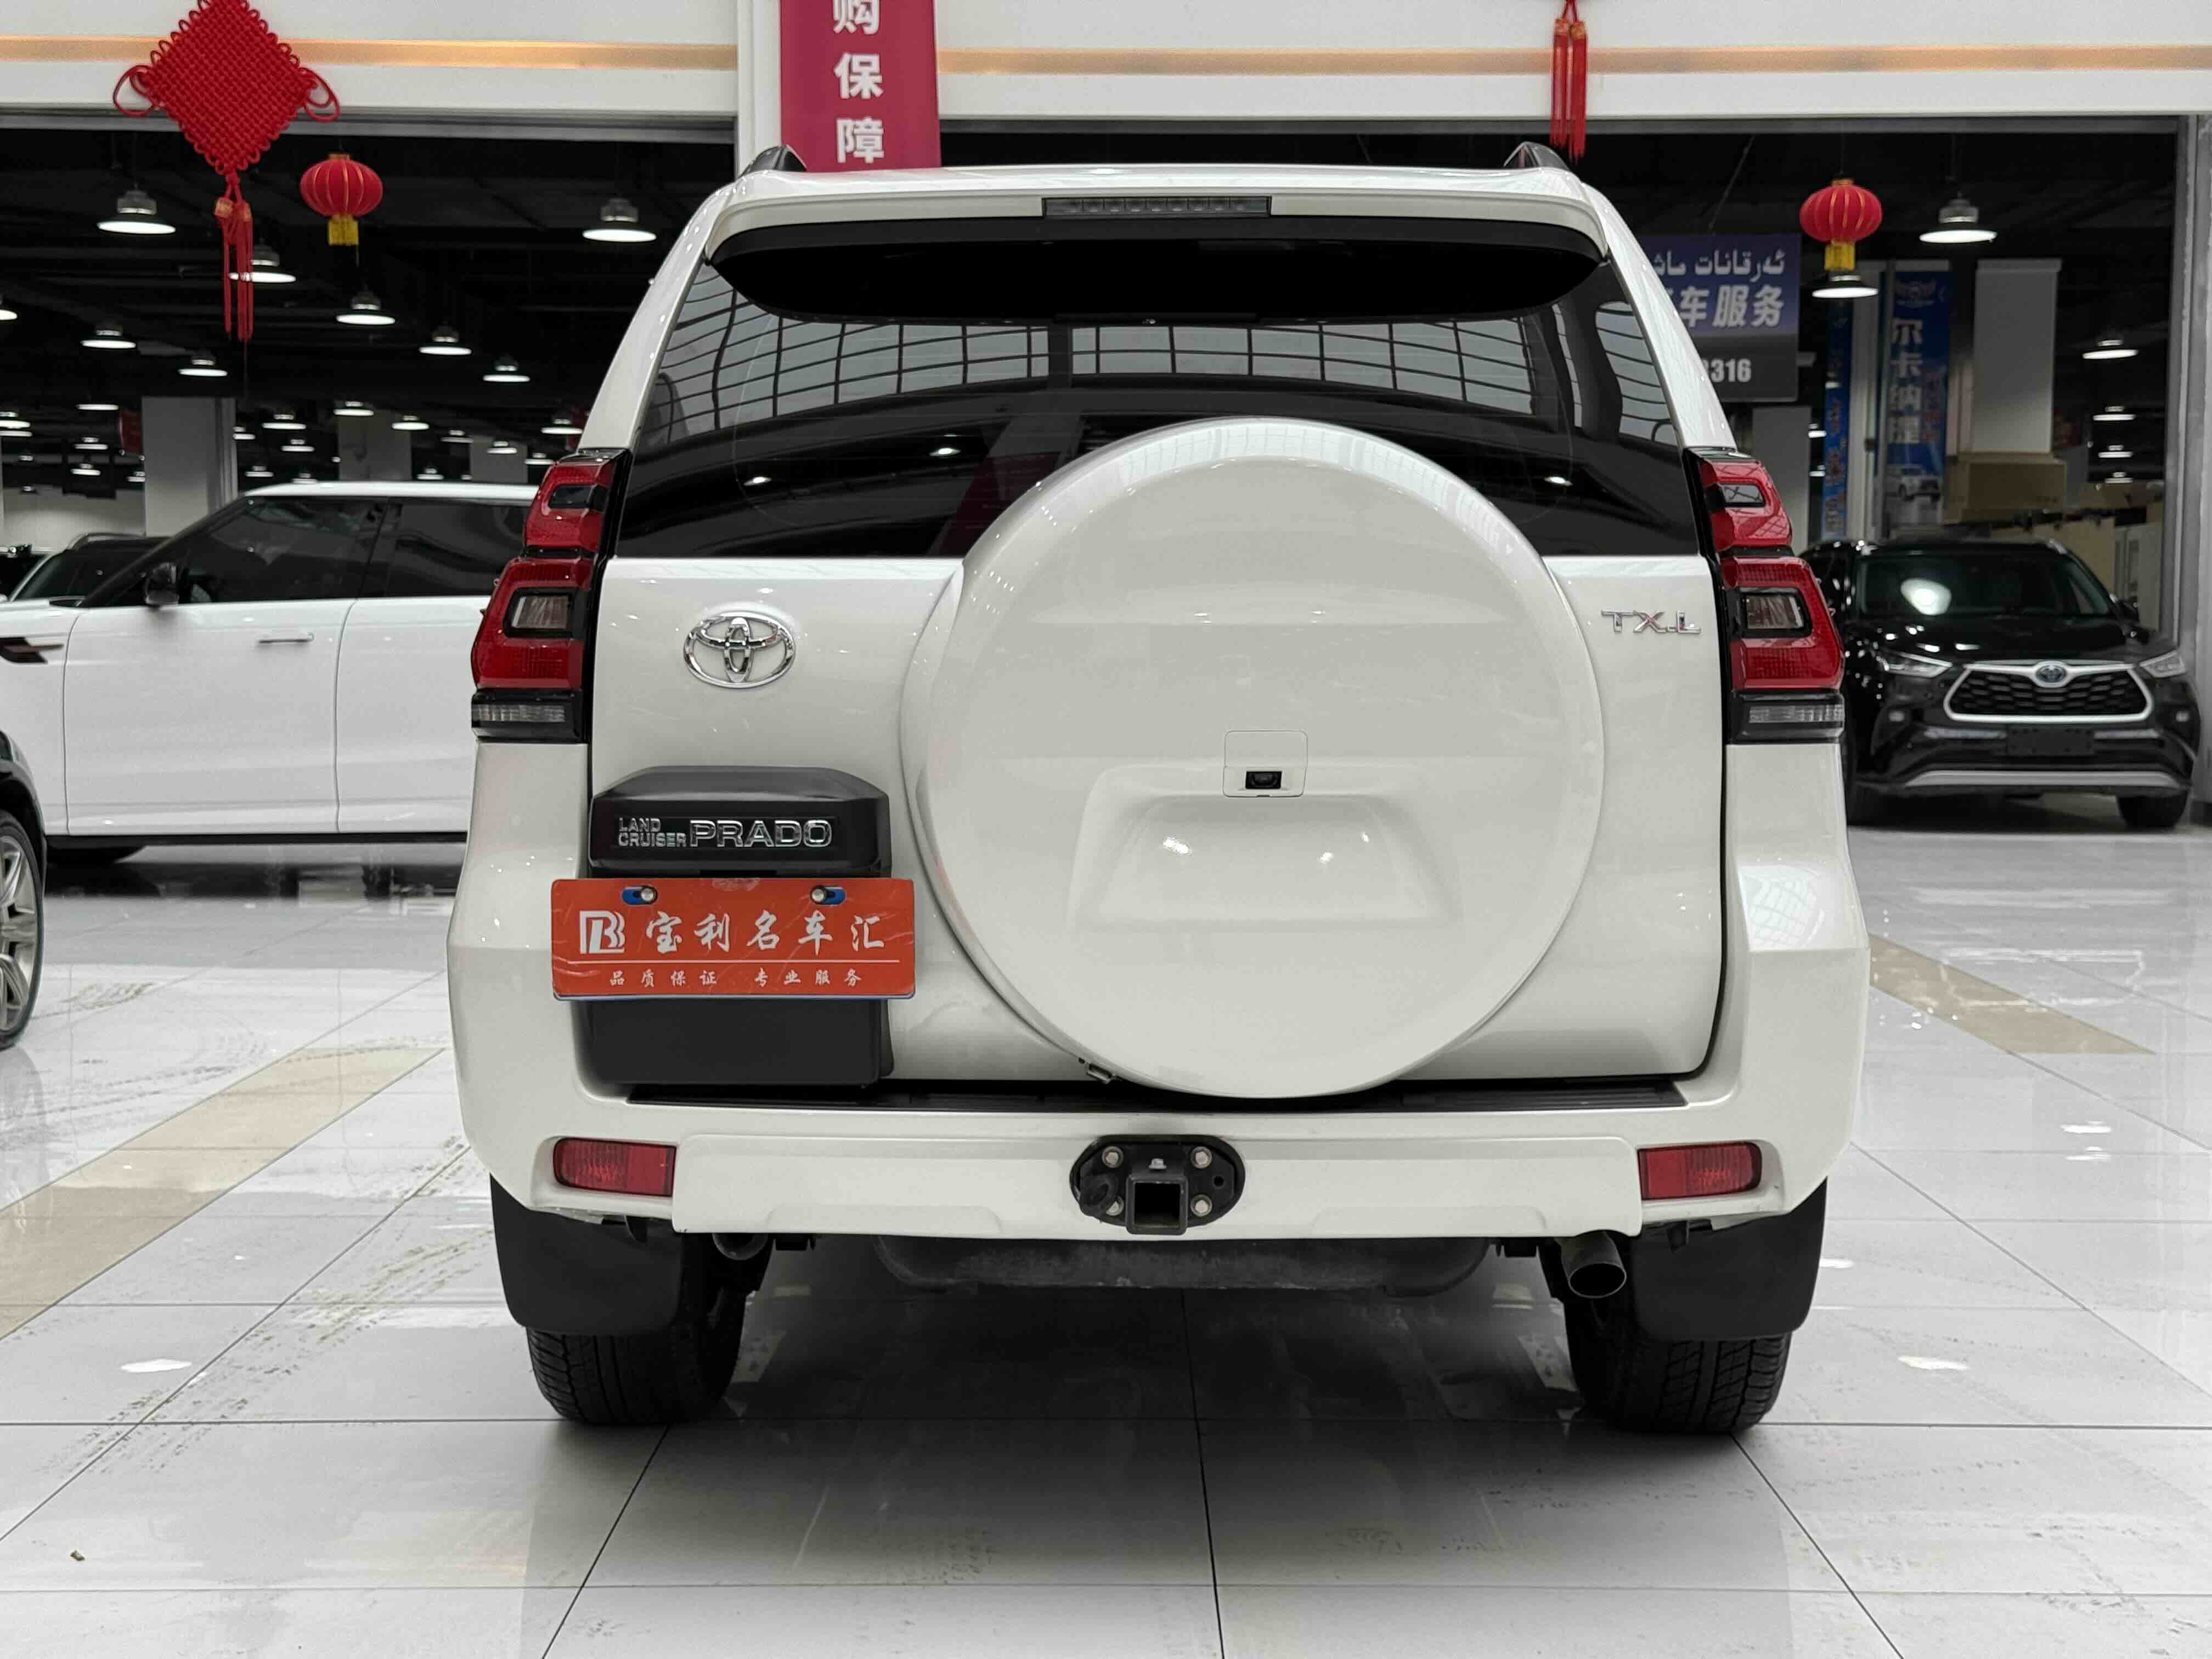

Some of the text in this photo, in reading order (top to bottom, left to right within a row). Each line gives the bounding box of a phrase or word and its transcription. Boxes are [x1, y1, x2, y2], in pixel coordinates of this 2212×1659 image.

[1666, 285, 1784, 328] 车服务
[618, 817, 661, 832] LAND
[689, 819, 832, 848] PRADO
[618, 832, 687, 848] CRUISER
[645, 909, 885, 953] 宝利名车汇
[609, 967, 862, 988] 品质保证 专业服务
